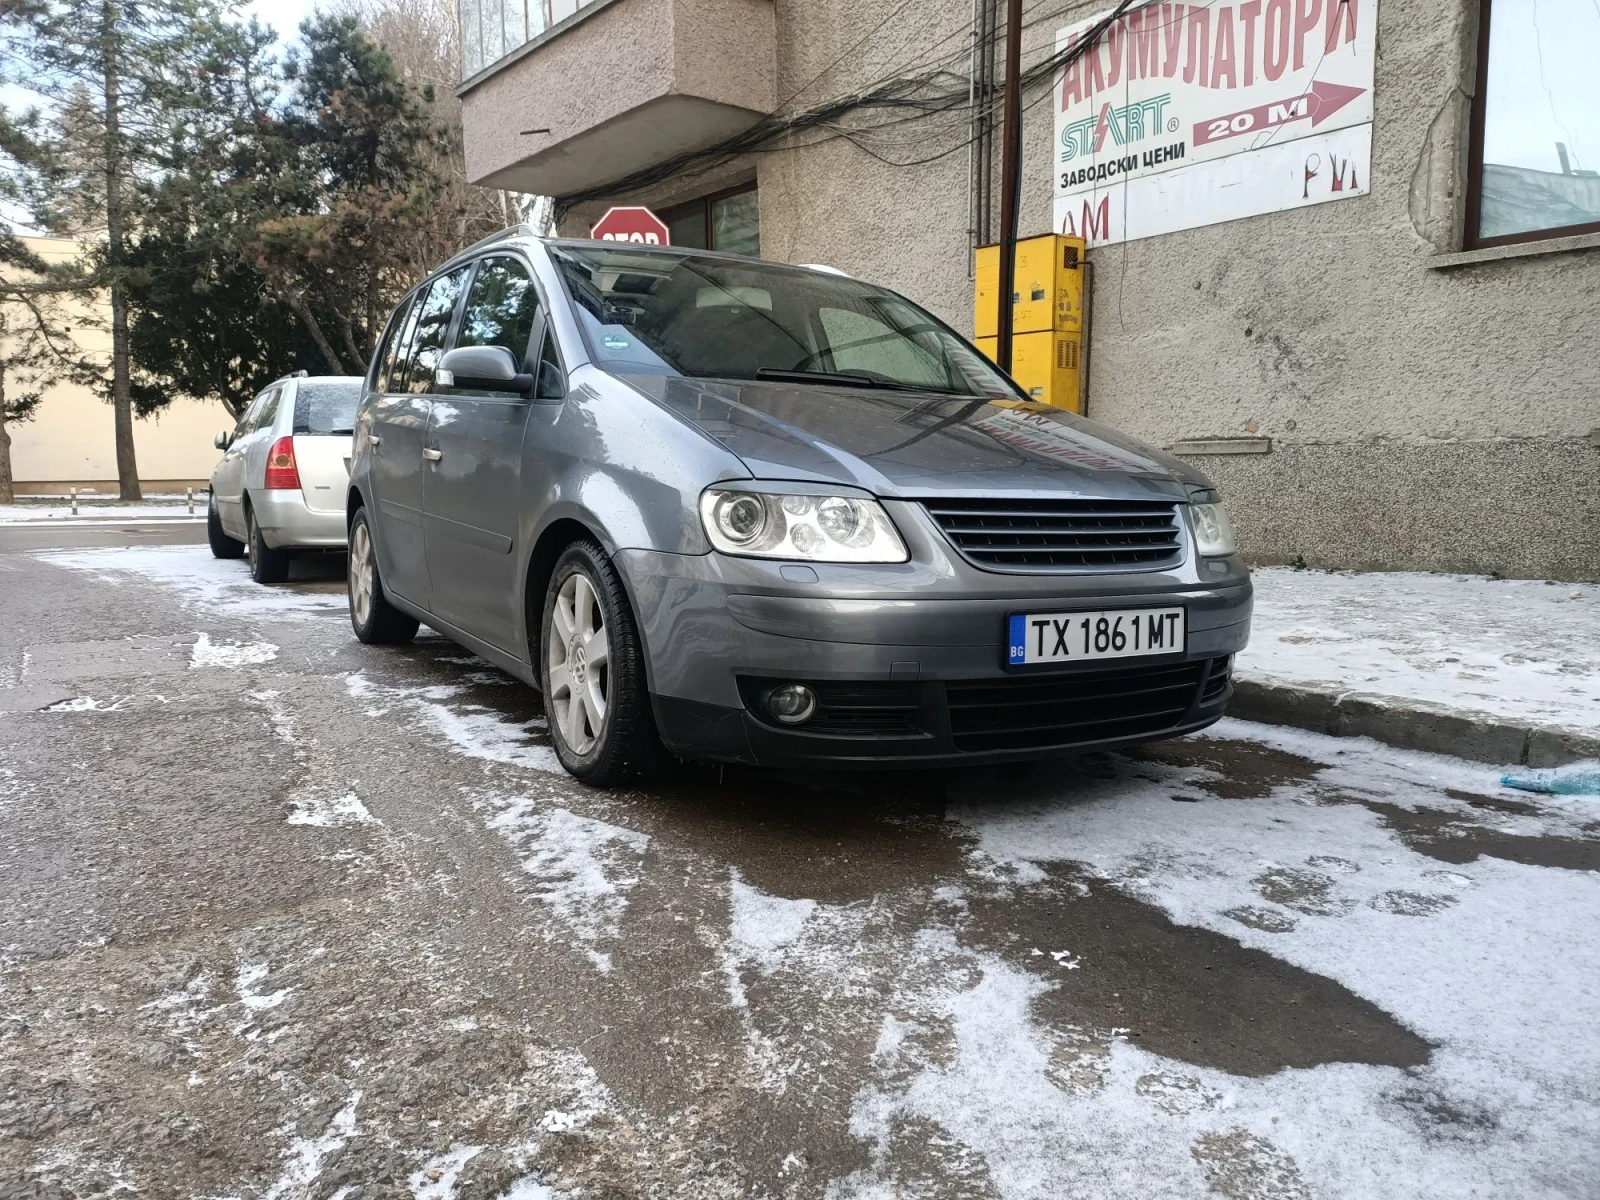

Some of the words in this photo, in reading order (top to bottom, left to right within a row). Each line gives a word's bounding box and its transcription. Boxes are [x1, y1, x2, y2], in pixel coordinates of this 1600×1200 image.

[1061, 92, 1171, 163] START
[1207, 114, 1254, 140] 20
[1268, 97, 1308, 124] М
[1060, 154, 1138, 189] ЗАВОДСКИ
[1143, 141, 1185, 168] ЦЕНИ
[1010, 645, 1024, 658] BG
[1031, 618, 1070, 656] TX
[1080, 615, 1140, 654] 1861
[1148, 612, 1180, 650] MT
